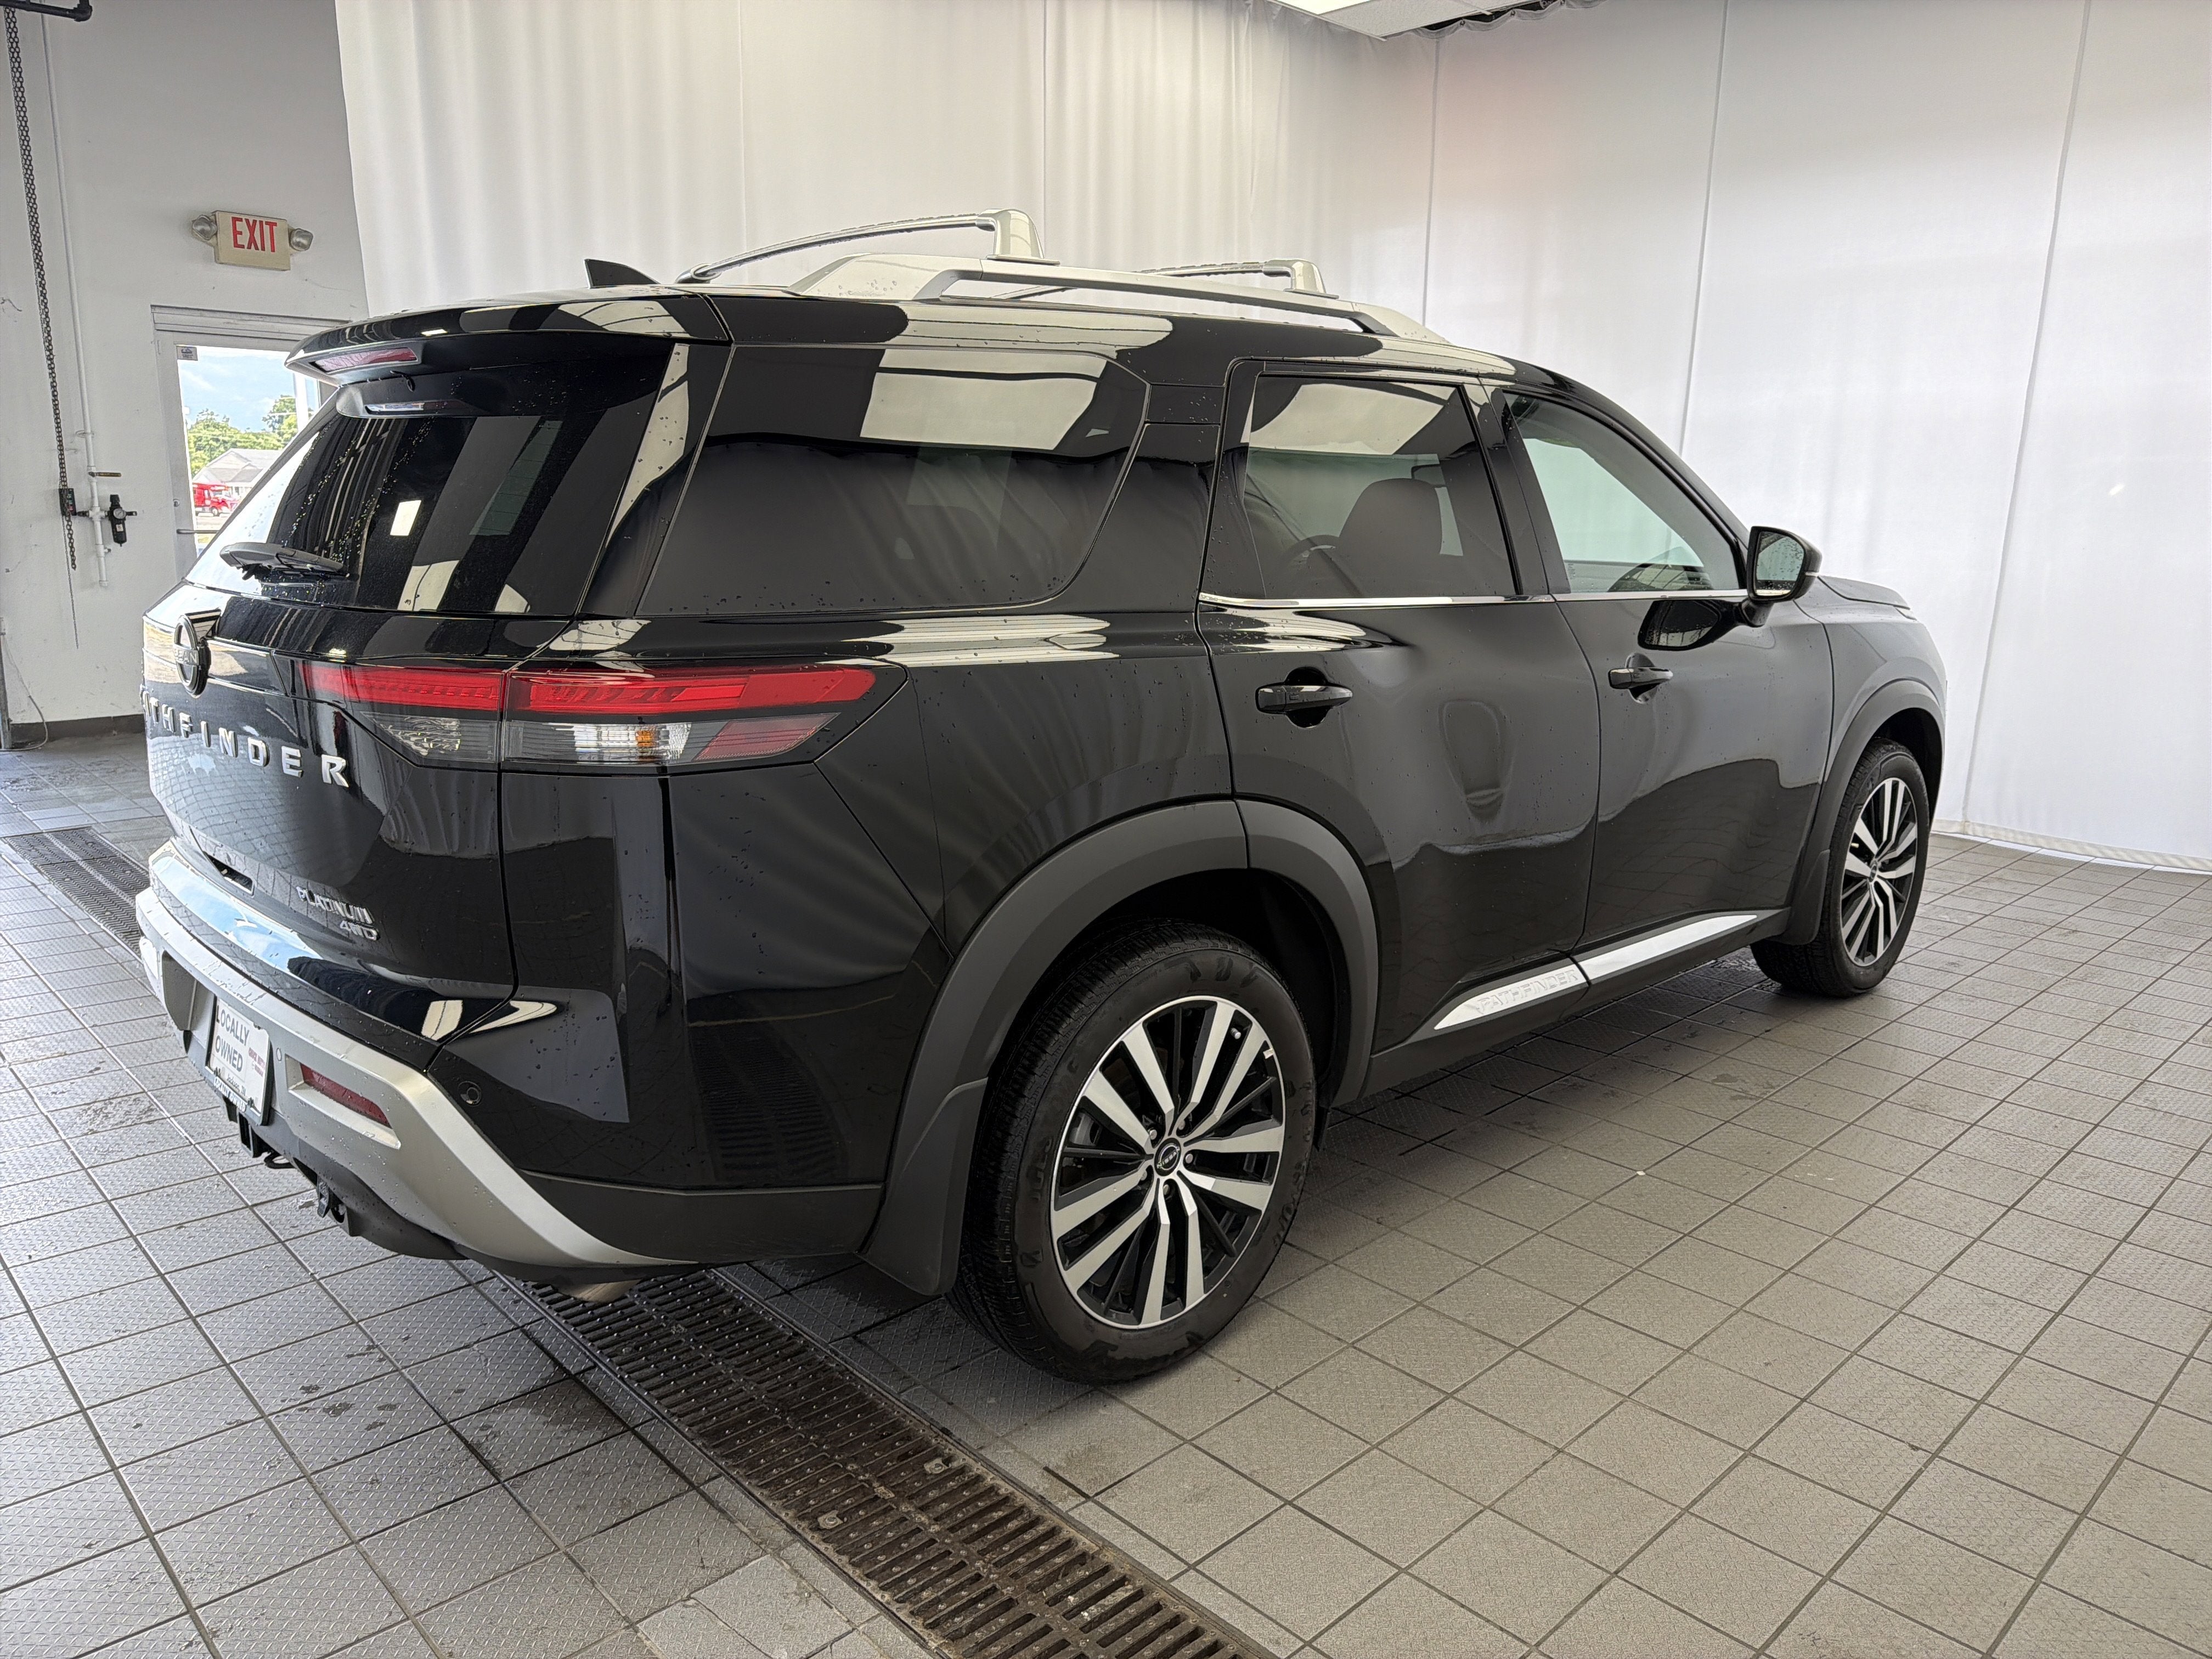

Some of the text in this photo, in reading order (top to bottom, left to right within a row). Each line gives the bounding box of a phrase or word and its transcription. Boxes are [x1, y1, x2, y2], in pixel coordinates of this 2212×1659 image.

[231, 216, 278, 252] EXIT
[296, 886, 375, 924] PLATINUM
[340, 920, 380, 941] 4WD
[1477, 969, 1578, 1012] PATHFINDER
[216, 1005, 250, 1046] LOCALLY
[215, 1035, 243, 1073] OWNED
